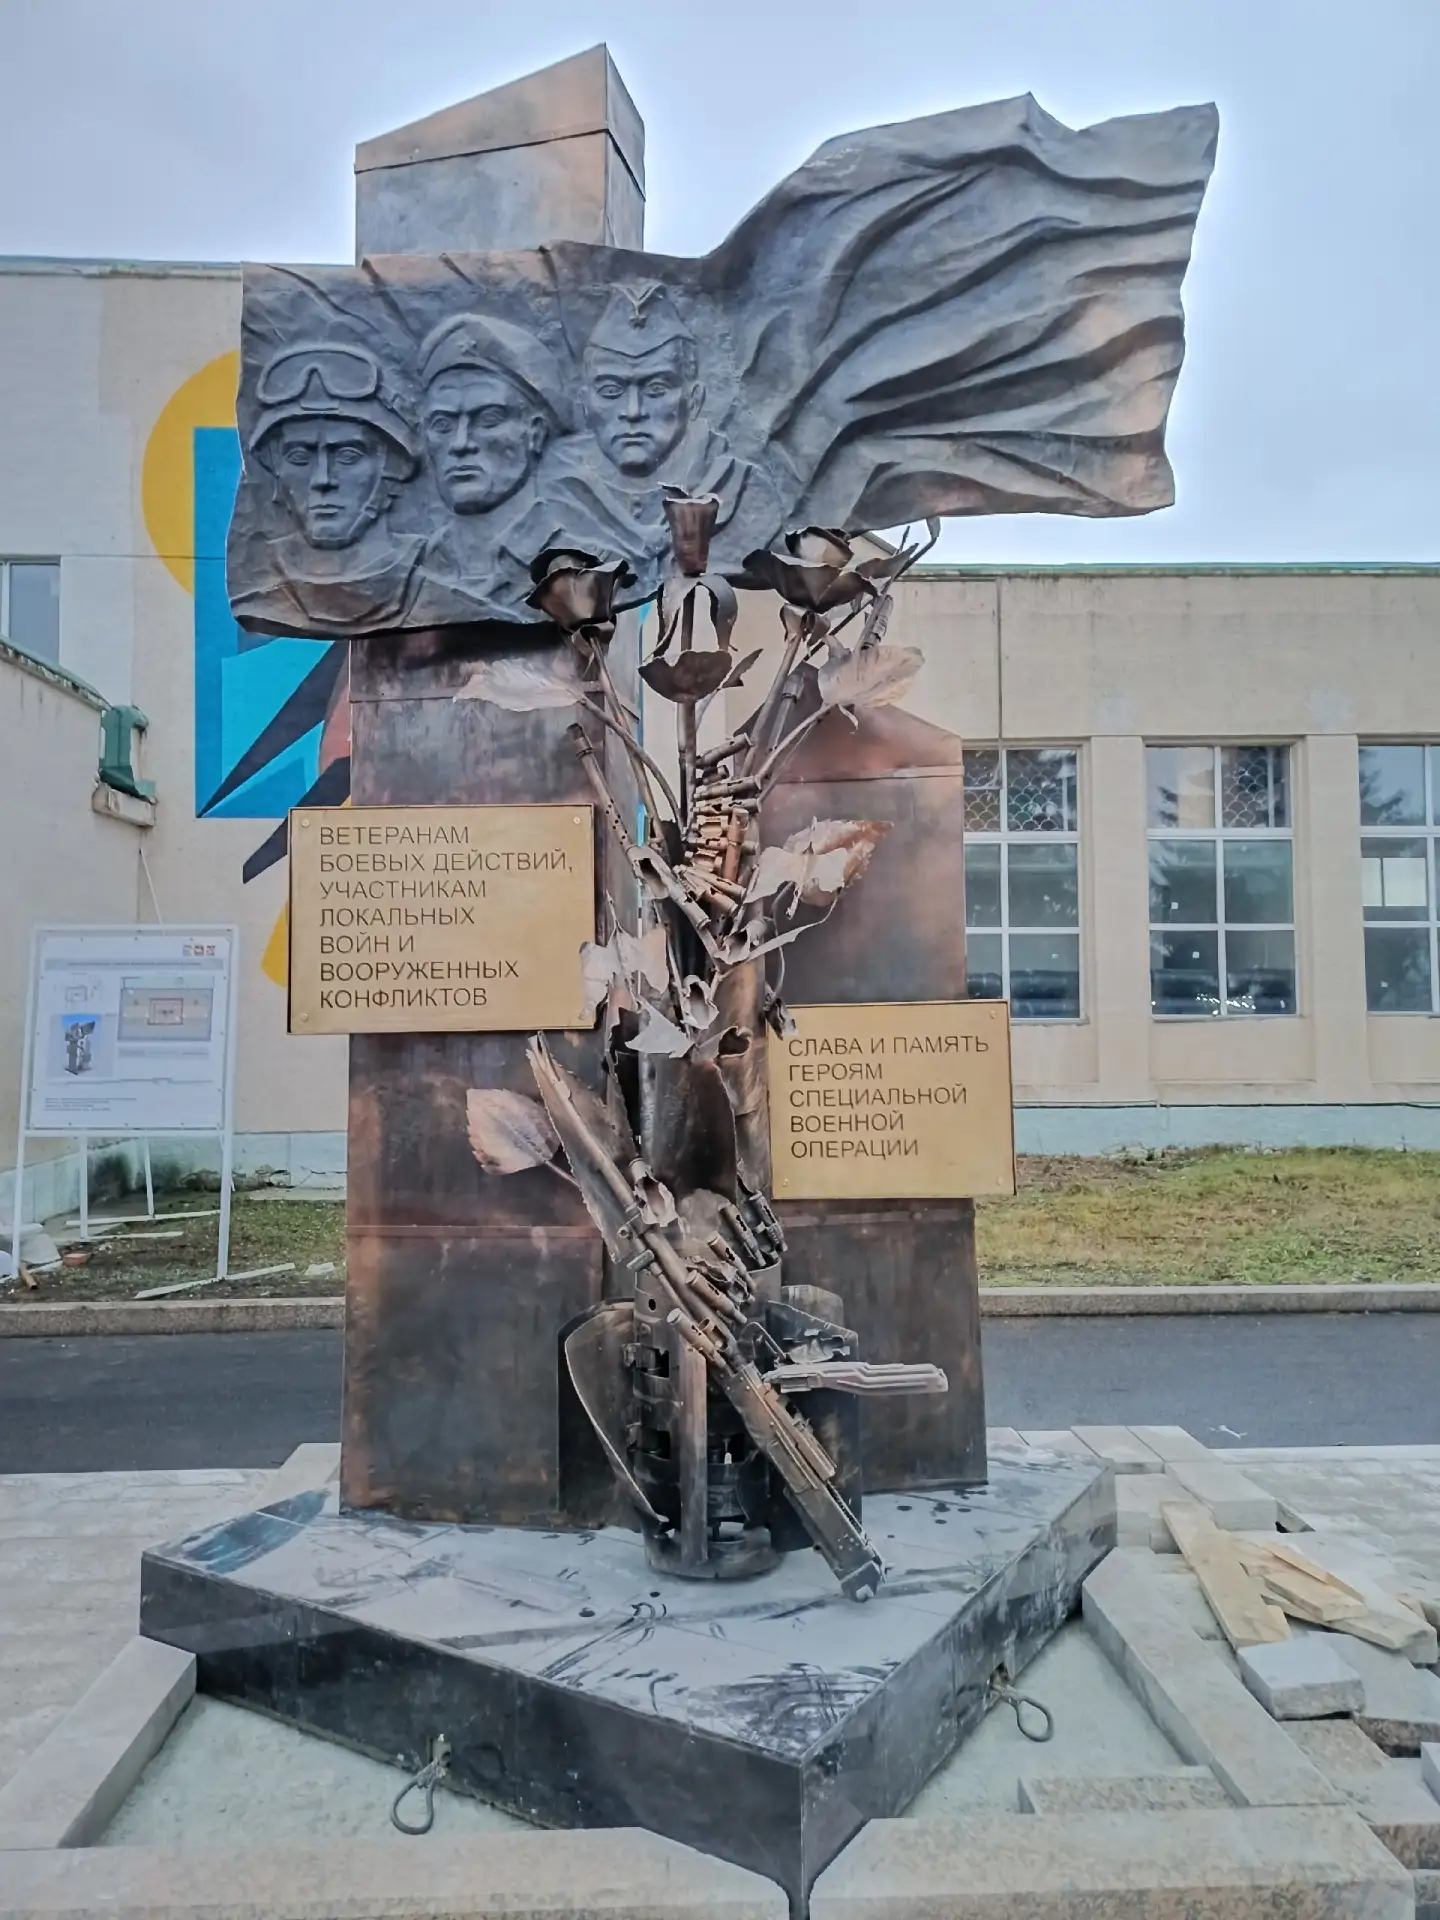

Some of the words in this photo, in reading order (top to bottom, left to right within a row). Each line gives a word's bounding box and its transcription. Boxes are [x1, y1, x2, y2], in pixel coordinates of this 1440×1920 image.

[320, 826, 469, 846] ВЕТЕРАНАМ
[320, 853, 425, 873] БОЕВЫХ
[432, 848, 573, 874] ДЕЙСТВИЙ,
[320, 880, 486, 900] УЧАСТНИКАМ
[320, 907, 475, 927] ЛОКАЛЬНЫХ
[320, 932, 389, 954] ВОЙН
[399, 935, 414, 953] И
[320, 960, 519, 982] ВООРУЖЕННЫХ
[320, 988, 487, 1009] КОНФЛИКТОВ
[788, 1037, 863, 1057] СЛАВА
[871, 1037, 885, 1055] И
[893, 1035, 989, 1054] ПАМЯТЬ
[789, 1063, 883, 1082] ГЕРОЯМ
[789, 1083, 967, 1109] СПЕЦИАЛЬНОЙ
[791, 1110, 904, 1133] ВОЕННОЙ
[791, 1139, 919, 1160] ОПЕРАЦИИ
